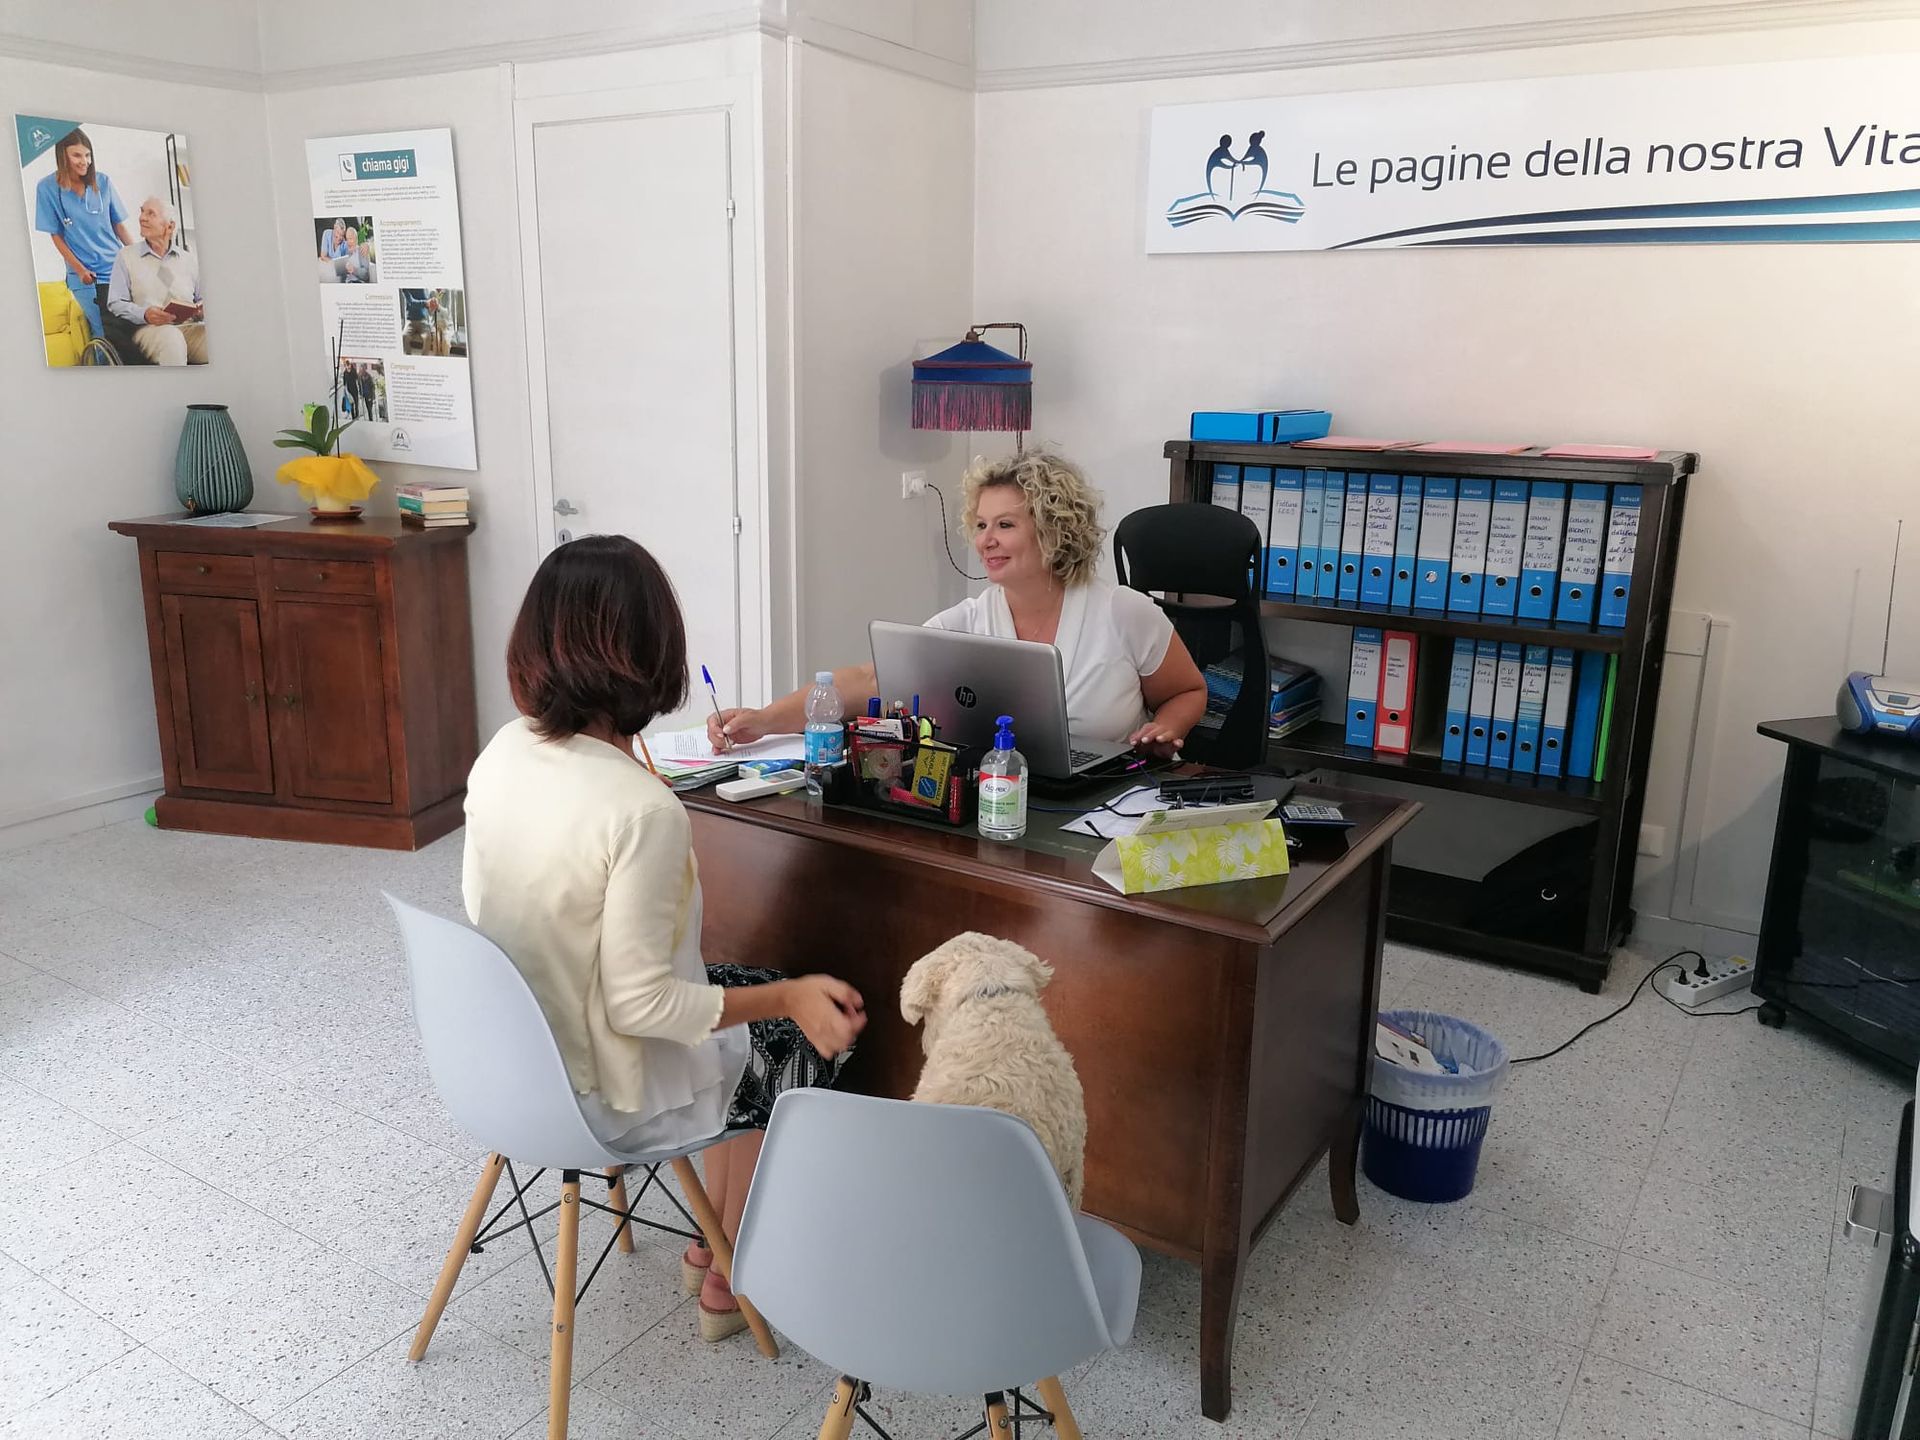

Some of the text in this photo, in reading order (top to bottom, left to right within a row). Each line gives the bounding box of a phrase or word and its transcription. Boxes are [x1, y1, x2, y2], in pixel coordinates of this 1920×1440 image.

[361, 154, 409, 174] chiama gigi
[1313, 124, 1920, 193] Le pagine della nostra Vita
[1537, 541, 1545, 550] 3
[959, 687, 973, 708] hp
